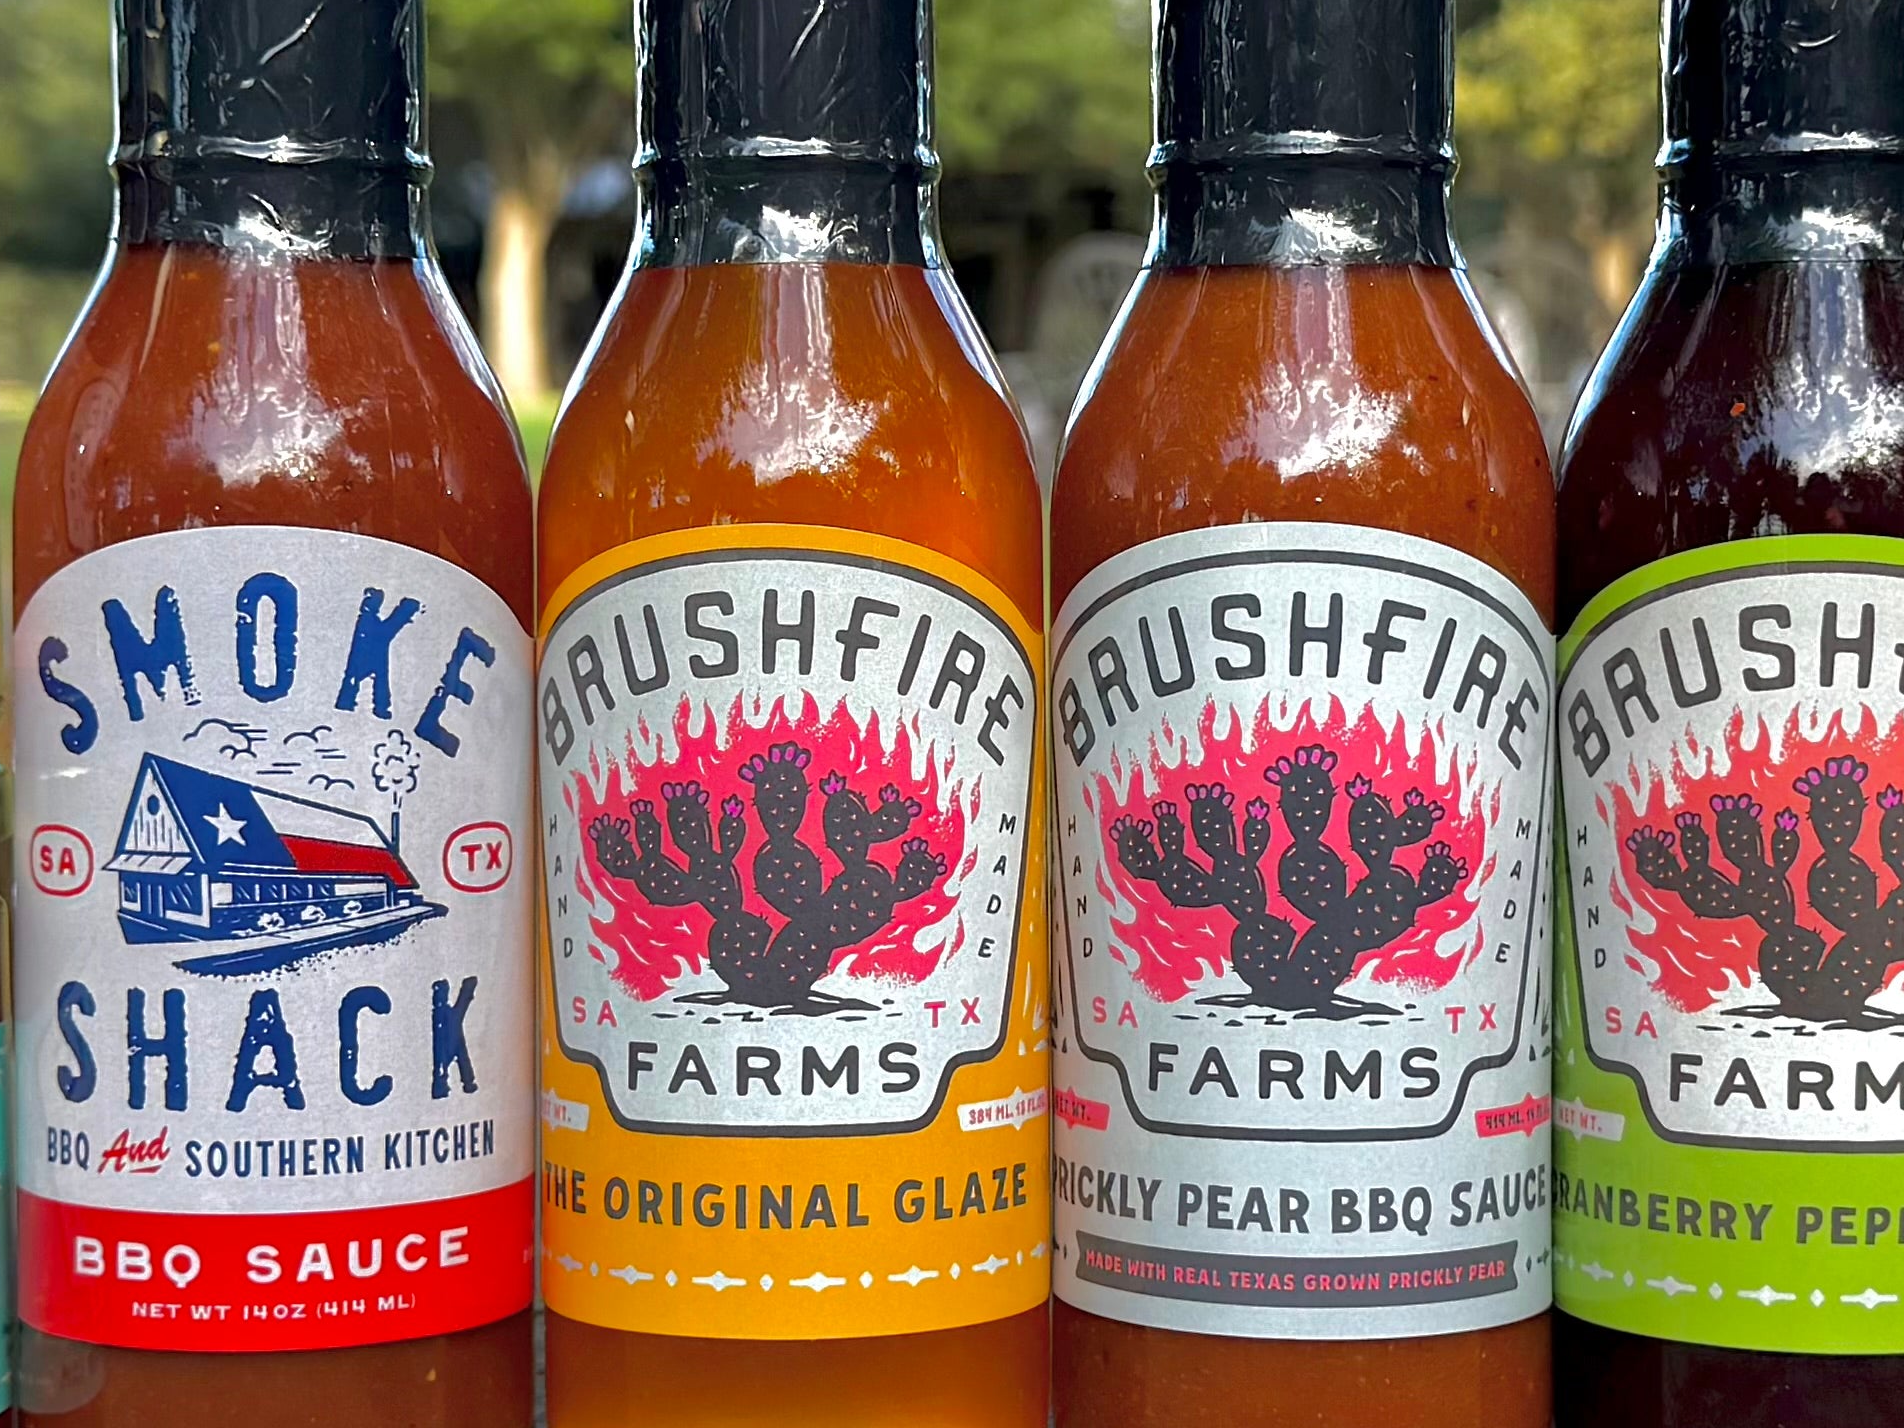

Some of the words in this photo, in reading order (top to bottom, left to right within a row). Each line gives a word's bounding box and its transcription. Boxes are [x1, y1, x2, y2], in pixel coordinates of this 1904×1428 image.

[38, 572, 496, 759] SMOKE
[543, 588, 1024, 766] BRUSHFIRE
[1060, 590, 1538, 771] BRUSHFIRE
[39, 847, 76, 876] SA
[461, 842, 503, 871] TX
[549, 813, 573, 959] HAND
[978, 813, 1016, 958] MADE
[1068, 816, 1094, 959] HAND
[1496, 818, 1530, 964] MADE
[1577, 826, 1608, 969] HAND
[573, 997, 617, 1027] SA
[925, 997, 981, 1027] TX
[1093, 997, 1138, 1029] SA
[1445, 1004, 1496, 1034] TX
[1606, 1006, 1657, 1039] SA
[56, 976, 479, 1112] SHACK
[627, 1042, 920, 1095] FARMS
[1148, 1044, 1439, 1100] FARMS
[48, 1127, 90, 1172] BBQ
[98, 1126, 170, 1174] And
[186, 1134, 364, 1178] SOUTHERN
[385, 1119, 494, 1170] KITCHEN
[544, 1161, 586, 1214] THE
[604, 1175, 868, 1228] ORIGINAL
[893, 1161, 1027, 1223] GLAZE
[1177, 1182, 1309, 1235] PEAR
[1330, 1187, 1433, 1236] BBQ
[1450, 1164, 1545, 1227] SAUCE
[74, 1236, 200, 1286] BBQ
[247, 1227, 470, 1282] SAUCE
[1086, 1251, 1122, 1272] MADE
[1128, 1260, 1165, 1281] WITH
[1174, 1266, 1221, 1287] REAL
[1229, 1271, 1294, 1290] TEXAS
[1303, 1273, 1380, 1290] GROWN
[1389, 1265, 1462, 1289] PRICKLY
[1468, 1260, 1505, 1281] PEAR
[132, 1303, 181, 1317] NET
[191, 1305, 231, 1320] WT
[317, 1298, 365, 1318] (414
[378, 1293, 416, 1310] ML)
